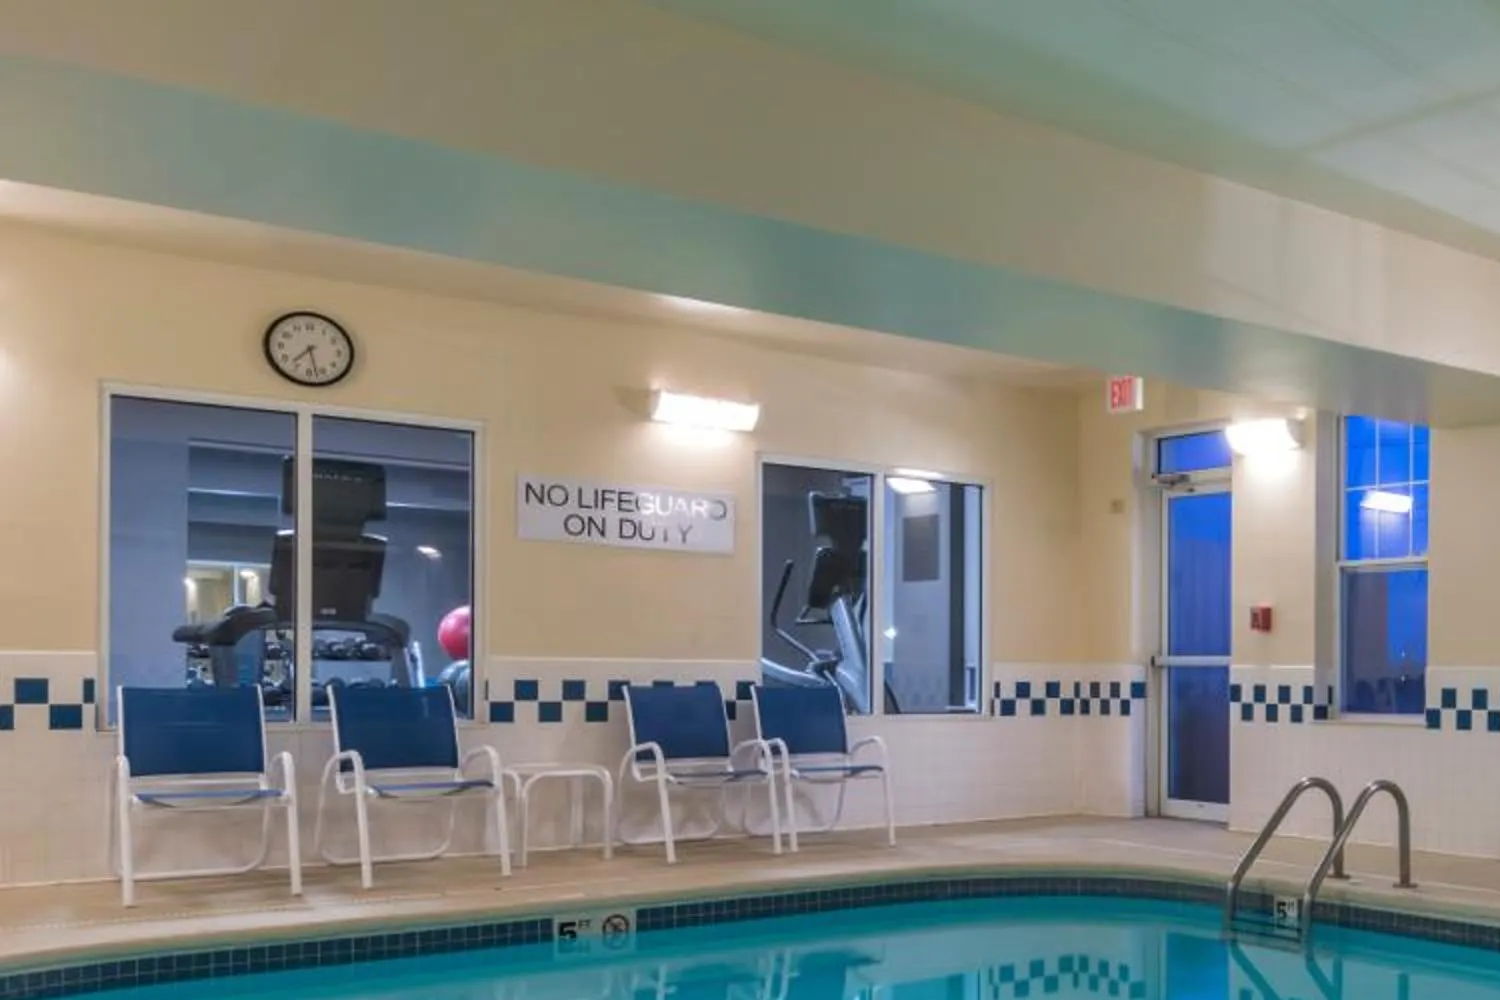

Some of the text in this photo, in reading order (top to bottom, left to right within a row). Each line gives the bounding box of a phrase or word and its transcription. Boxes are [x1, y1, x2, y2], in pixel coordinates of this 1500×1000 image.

[525, 481, 728, 522] NO LIFEGUARD
[563, 513, 606, 538] ON
[1277, 901, 1288, 919] 5
[559, 921, 577, 940] 5
